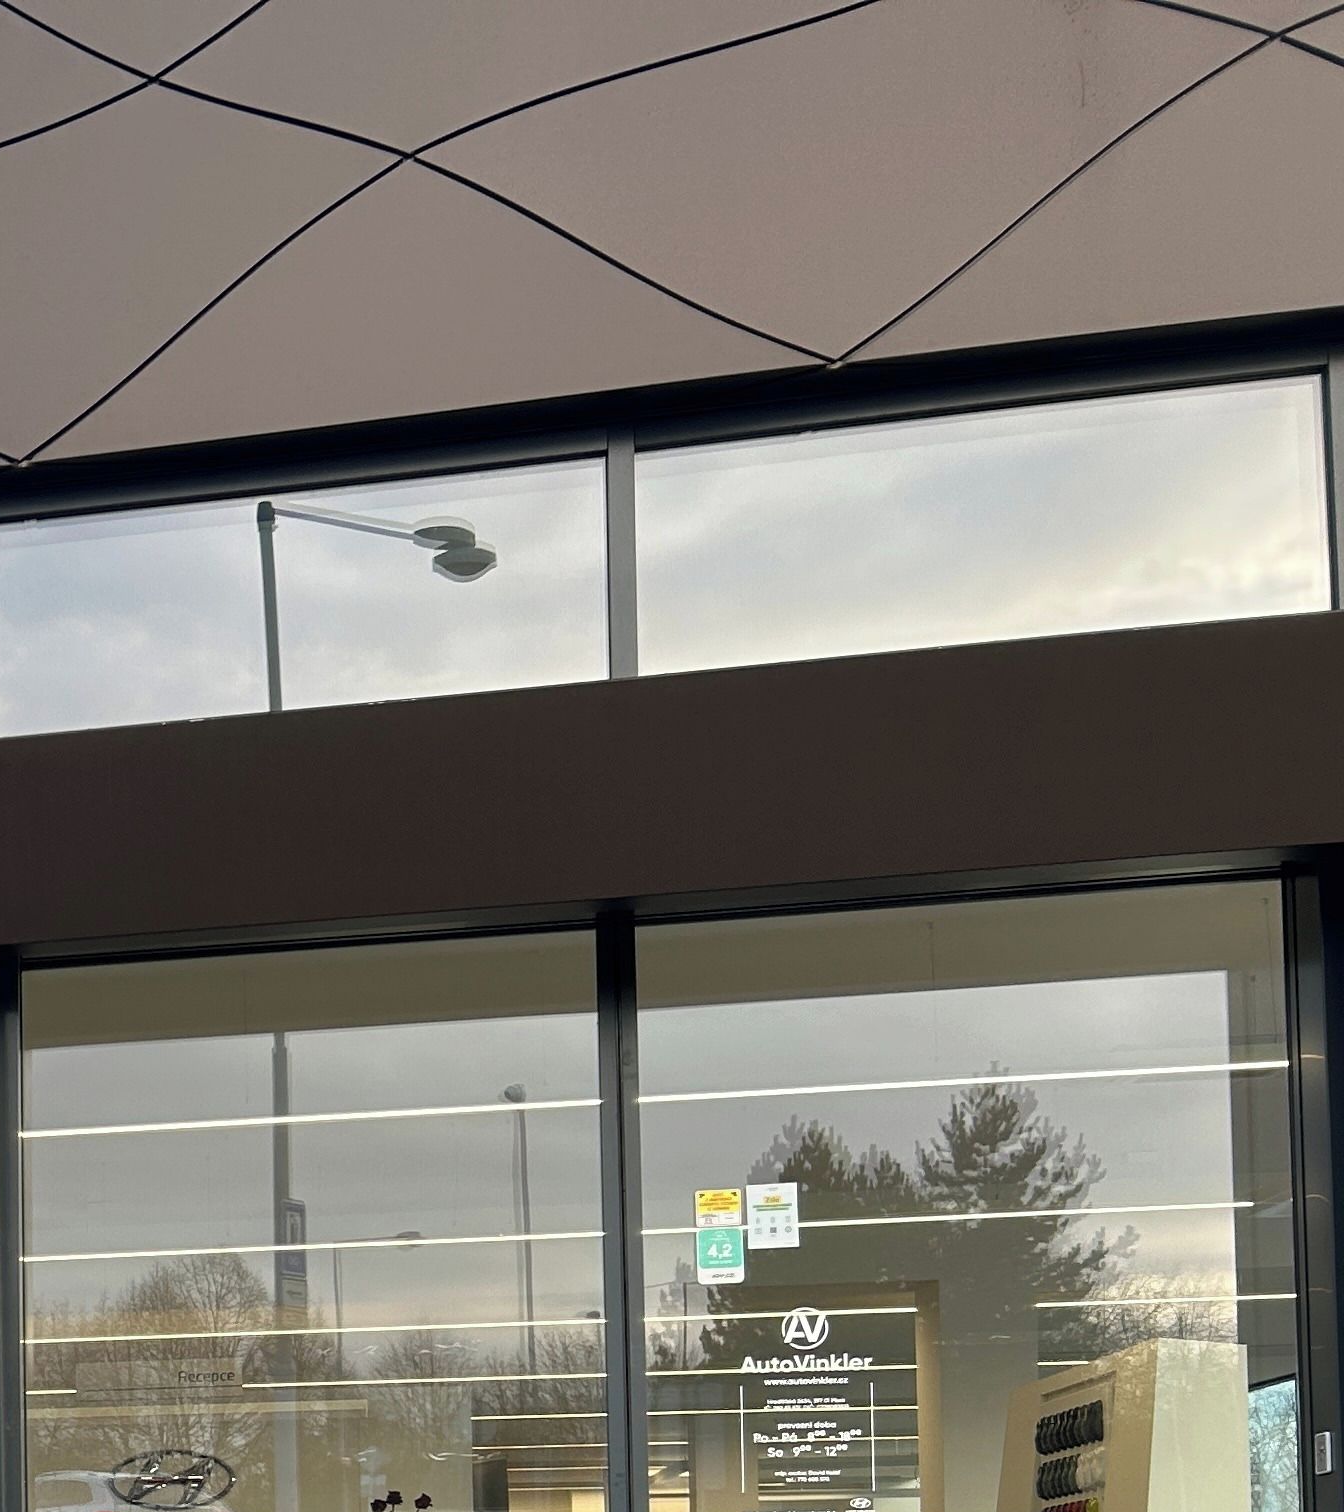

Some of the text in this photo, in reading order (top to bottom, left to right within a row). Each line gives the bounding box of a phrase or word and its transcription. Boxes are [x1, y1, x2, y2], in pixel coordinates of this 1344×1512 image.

[740, 1355, 873, 1373] AutoVinkler
[177, 1369, 236, 1385] Recepce
[767, 1447, 784, 1457] So
